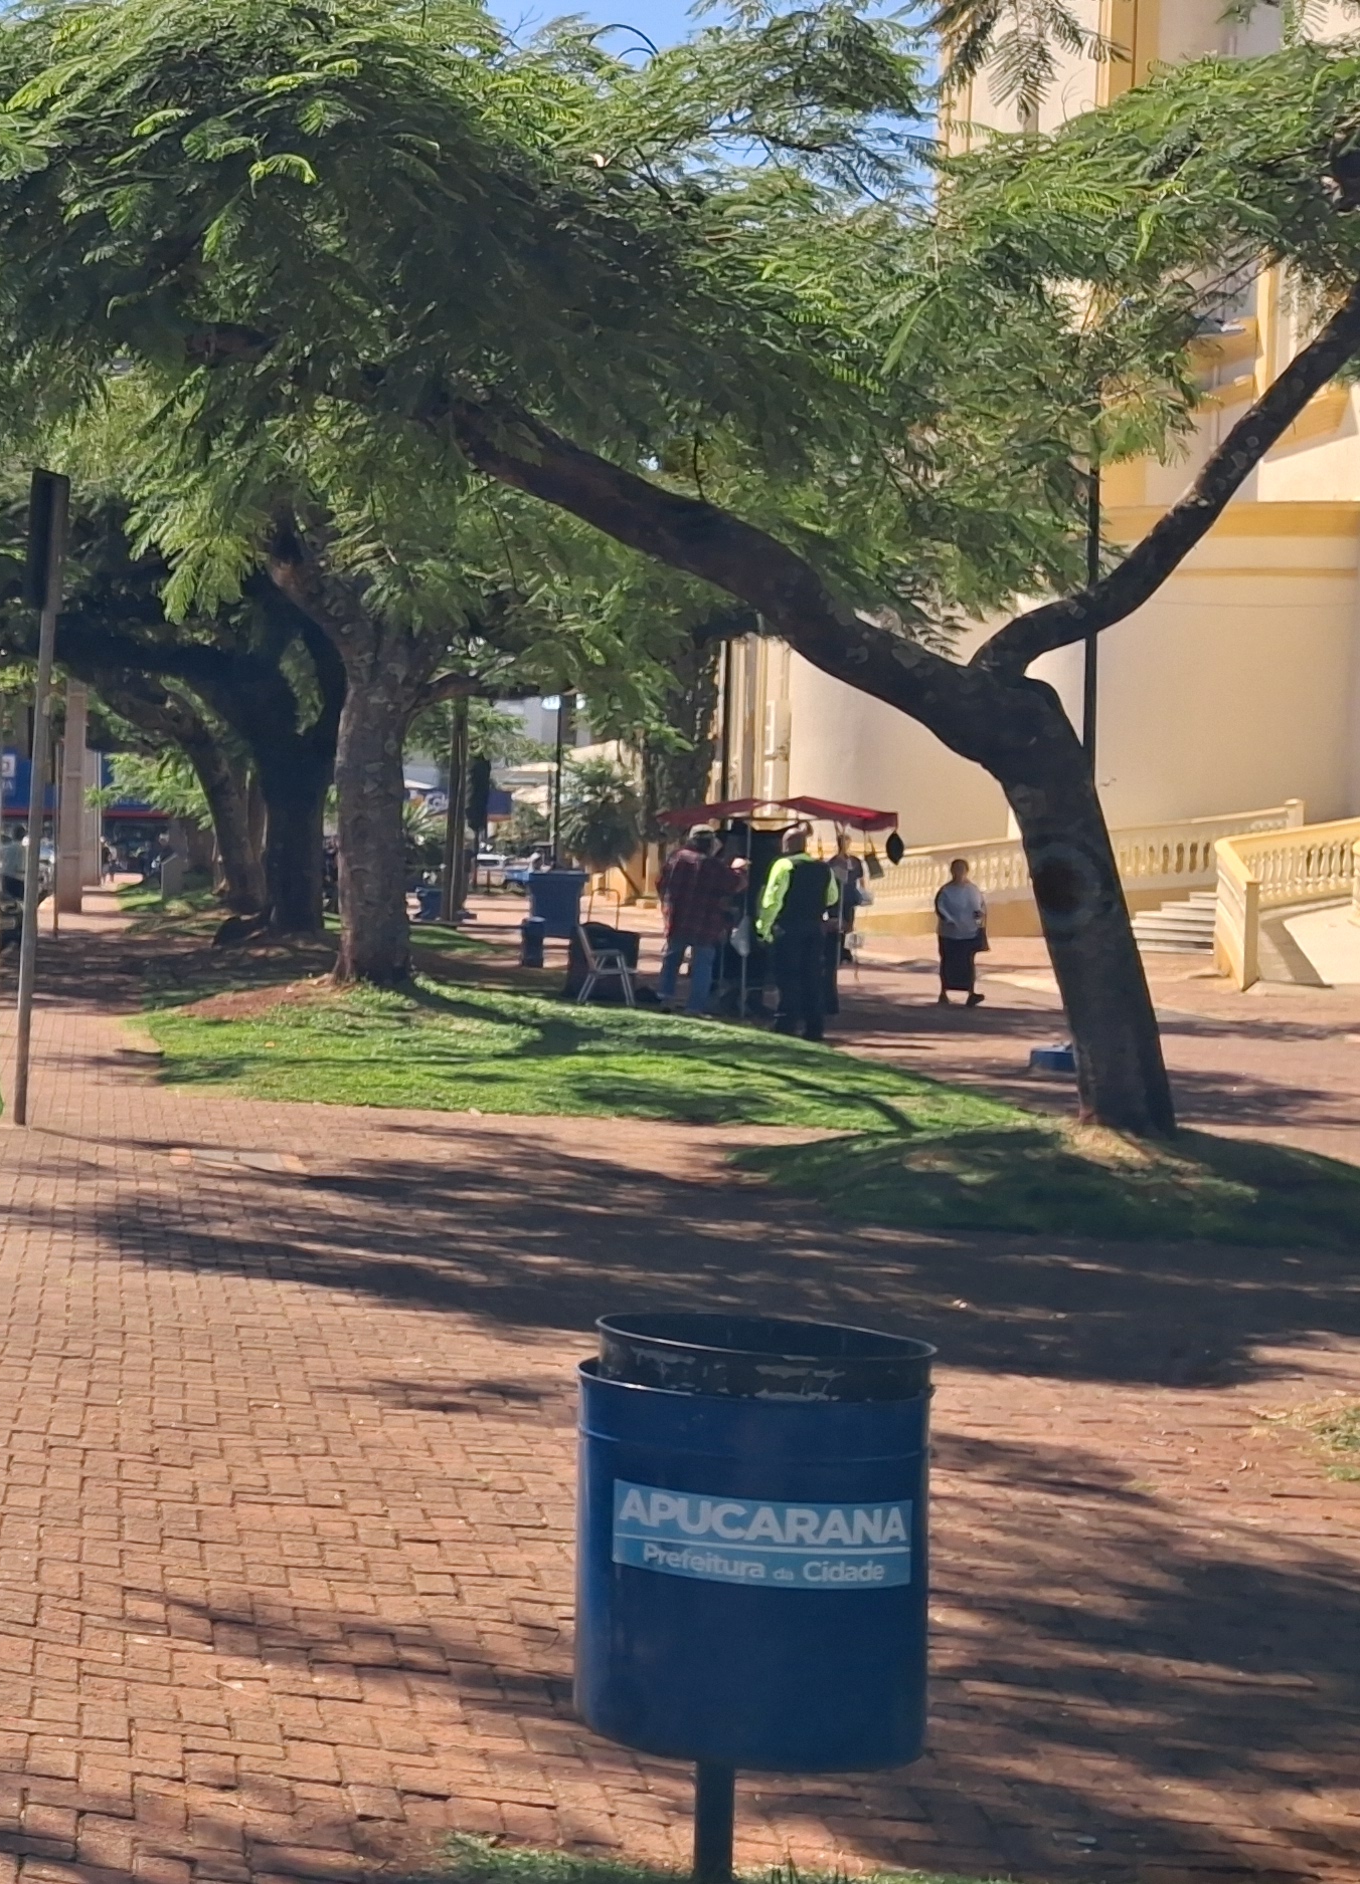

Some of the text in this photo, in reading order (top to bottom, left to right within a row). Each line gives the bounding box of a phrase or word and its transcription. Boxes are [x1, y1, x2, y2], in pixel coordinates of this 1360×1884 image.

[619, 1488, 907, 1546] APUCARANA
[643, 1542, 886, 1583] Prefeitura da Cidade
